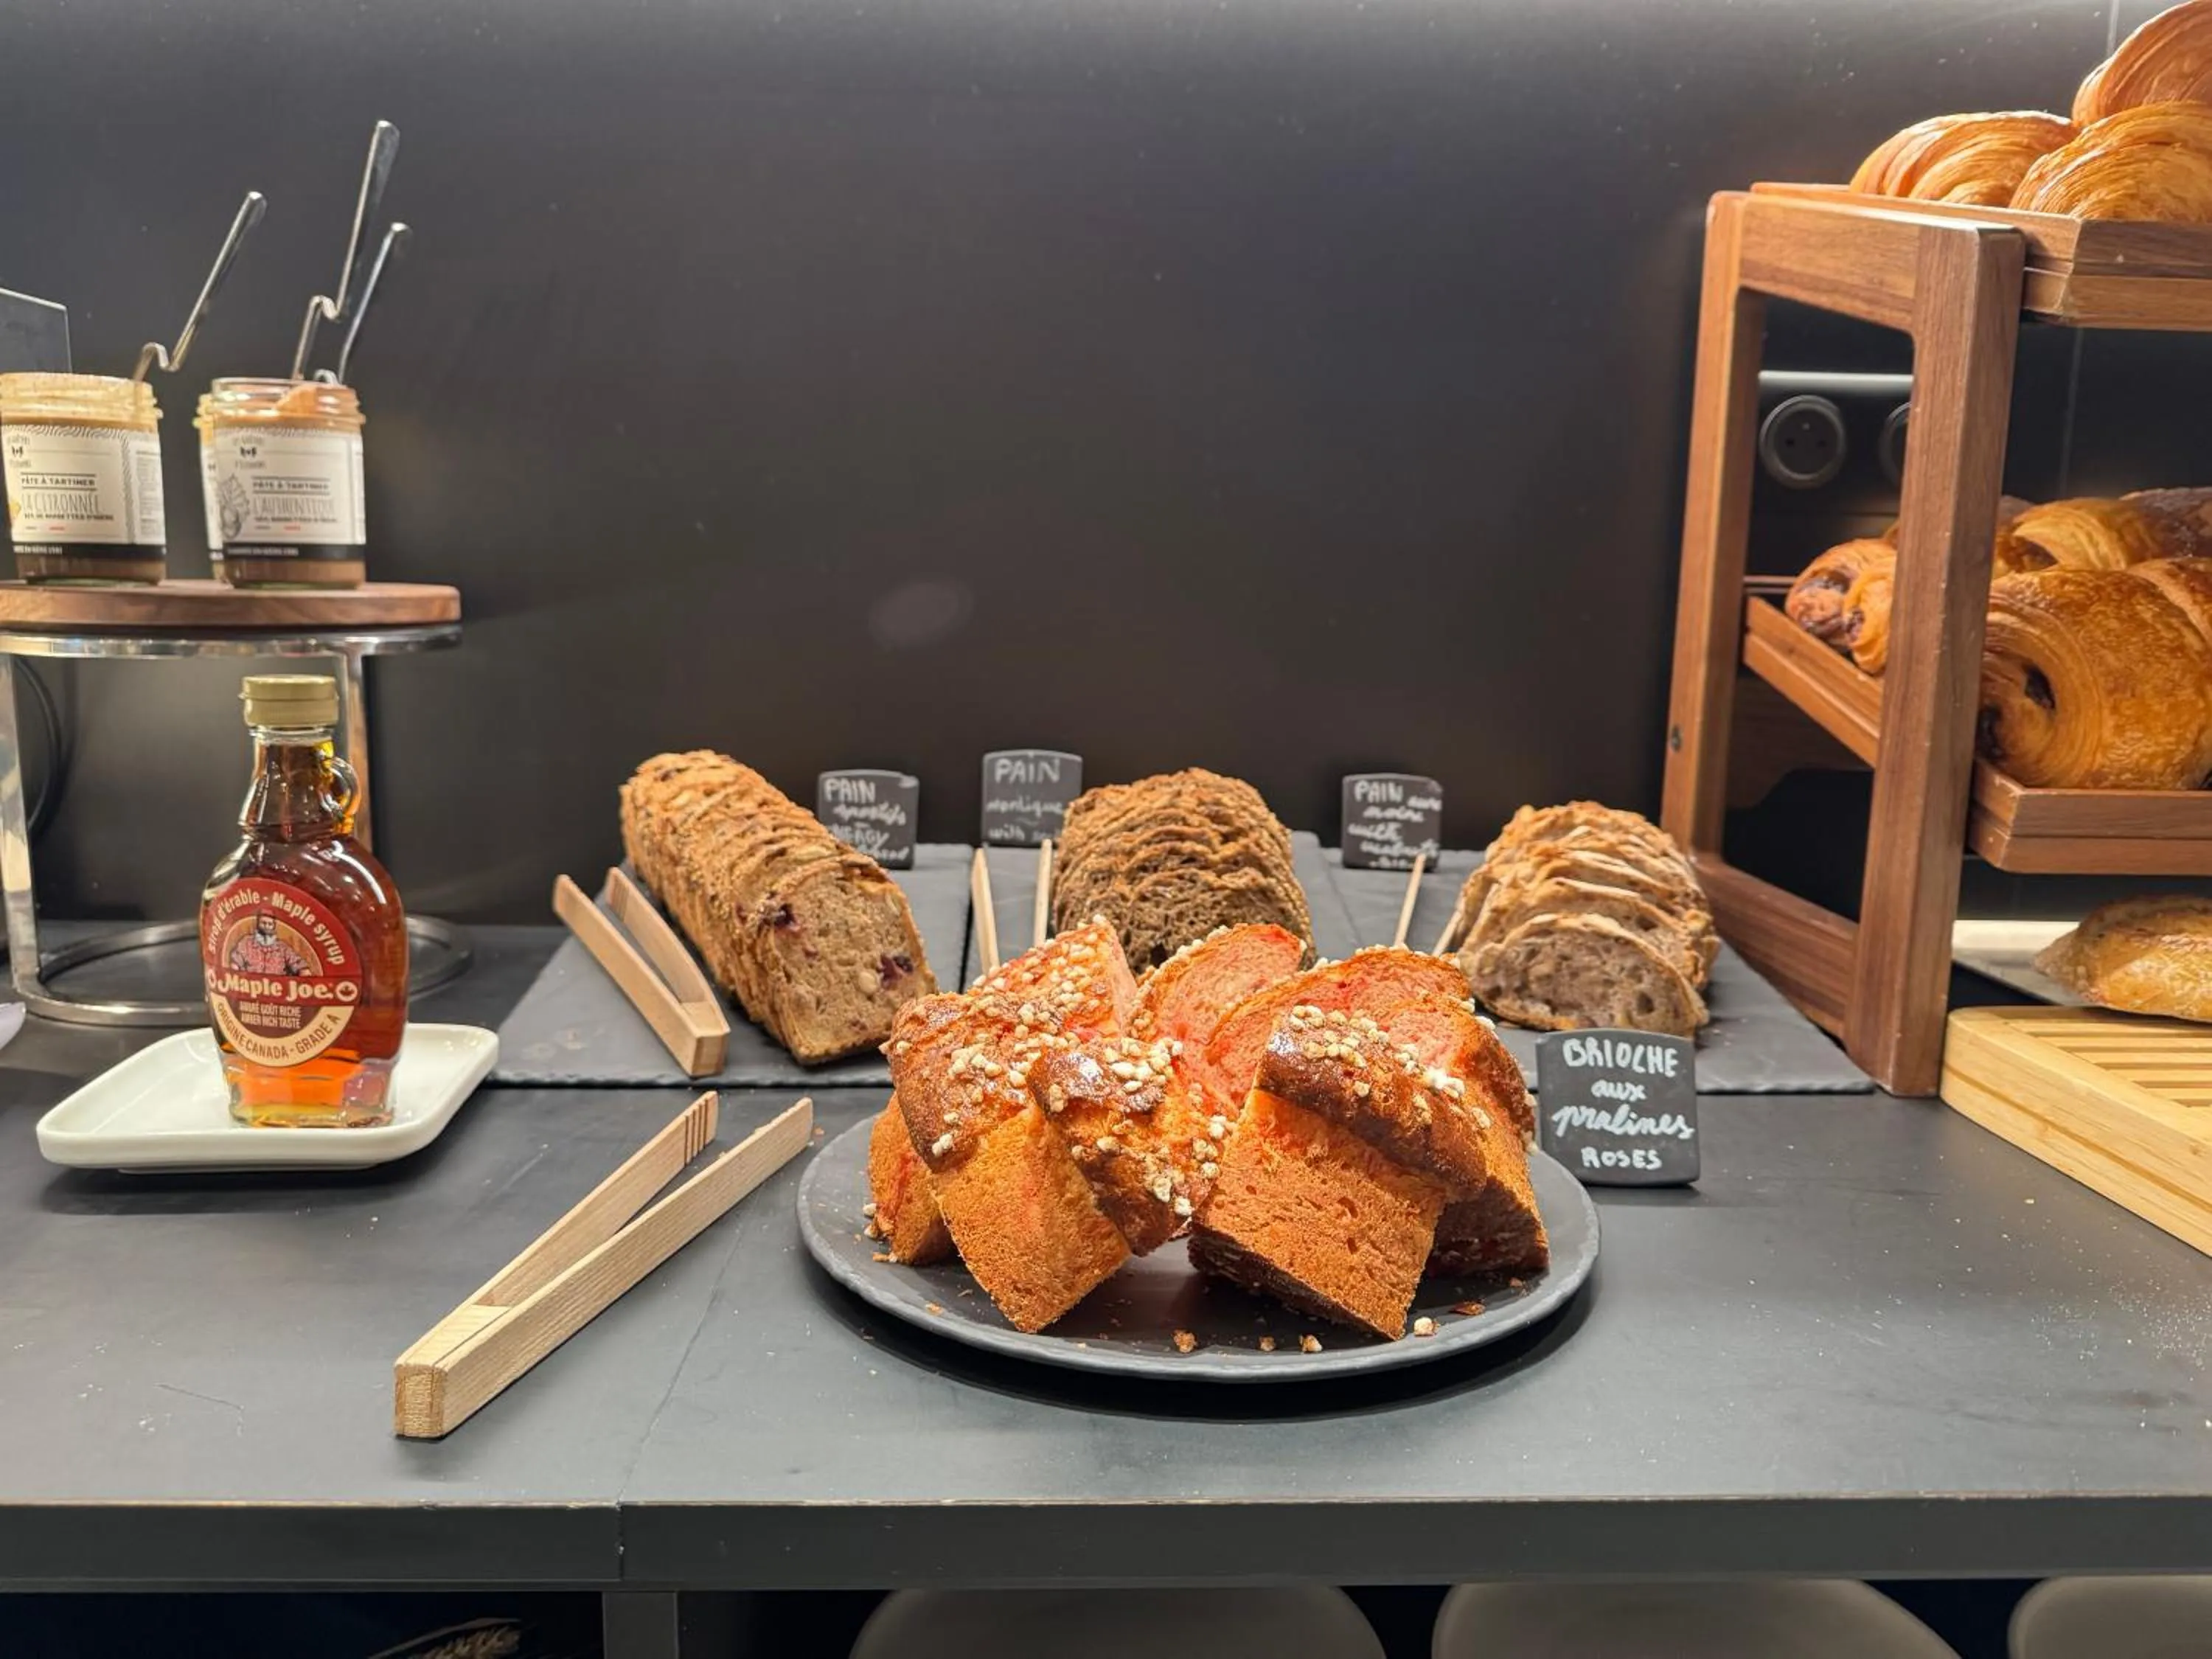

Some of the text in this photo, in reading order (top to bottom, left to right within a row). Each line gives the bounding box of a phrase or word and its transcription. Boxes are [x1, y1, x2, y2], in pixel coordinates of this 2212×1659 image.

[995, 757, 1060, 783] PAIN
[824, 778, 875, 804] PAIN
[1354, 780, 1403, 803] PAIN
[208, 914, 223, 954] sirop
[217, 888, 260, 920] d'érable
[271, 891, 316, 926] Maple
[313, 923, 345, 965] syrup
[218, 973, 283, 998] Maple
[217, 1001, 246, 1048] ORIGINE
[245, 1040, 291, 1060] CANADA
[296, 1022, 333, 1055] GRADE
[327, 1014, 341, 1025] A
[279, 1017, 301, 1029] TASTE
[1562, 1037, 1679, 1077] BRIOCHE
[1591, 1079, 1647, 1102] aux
[1551, 1104, 1695, 1140] pralines
[1581, 1147, 1663, 1170] ROSES
